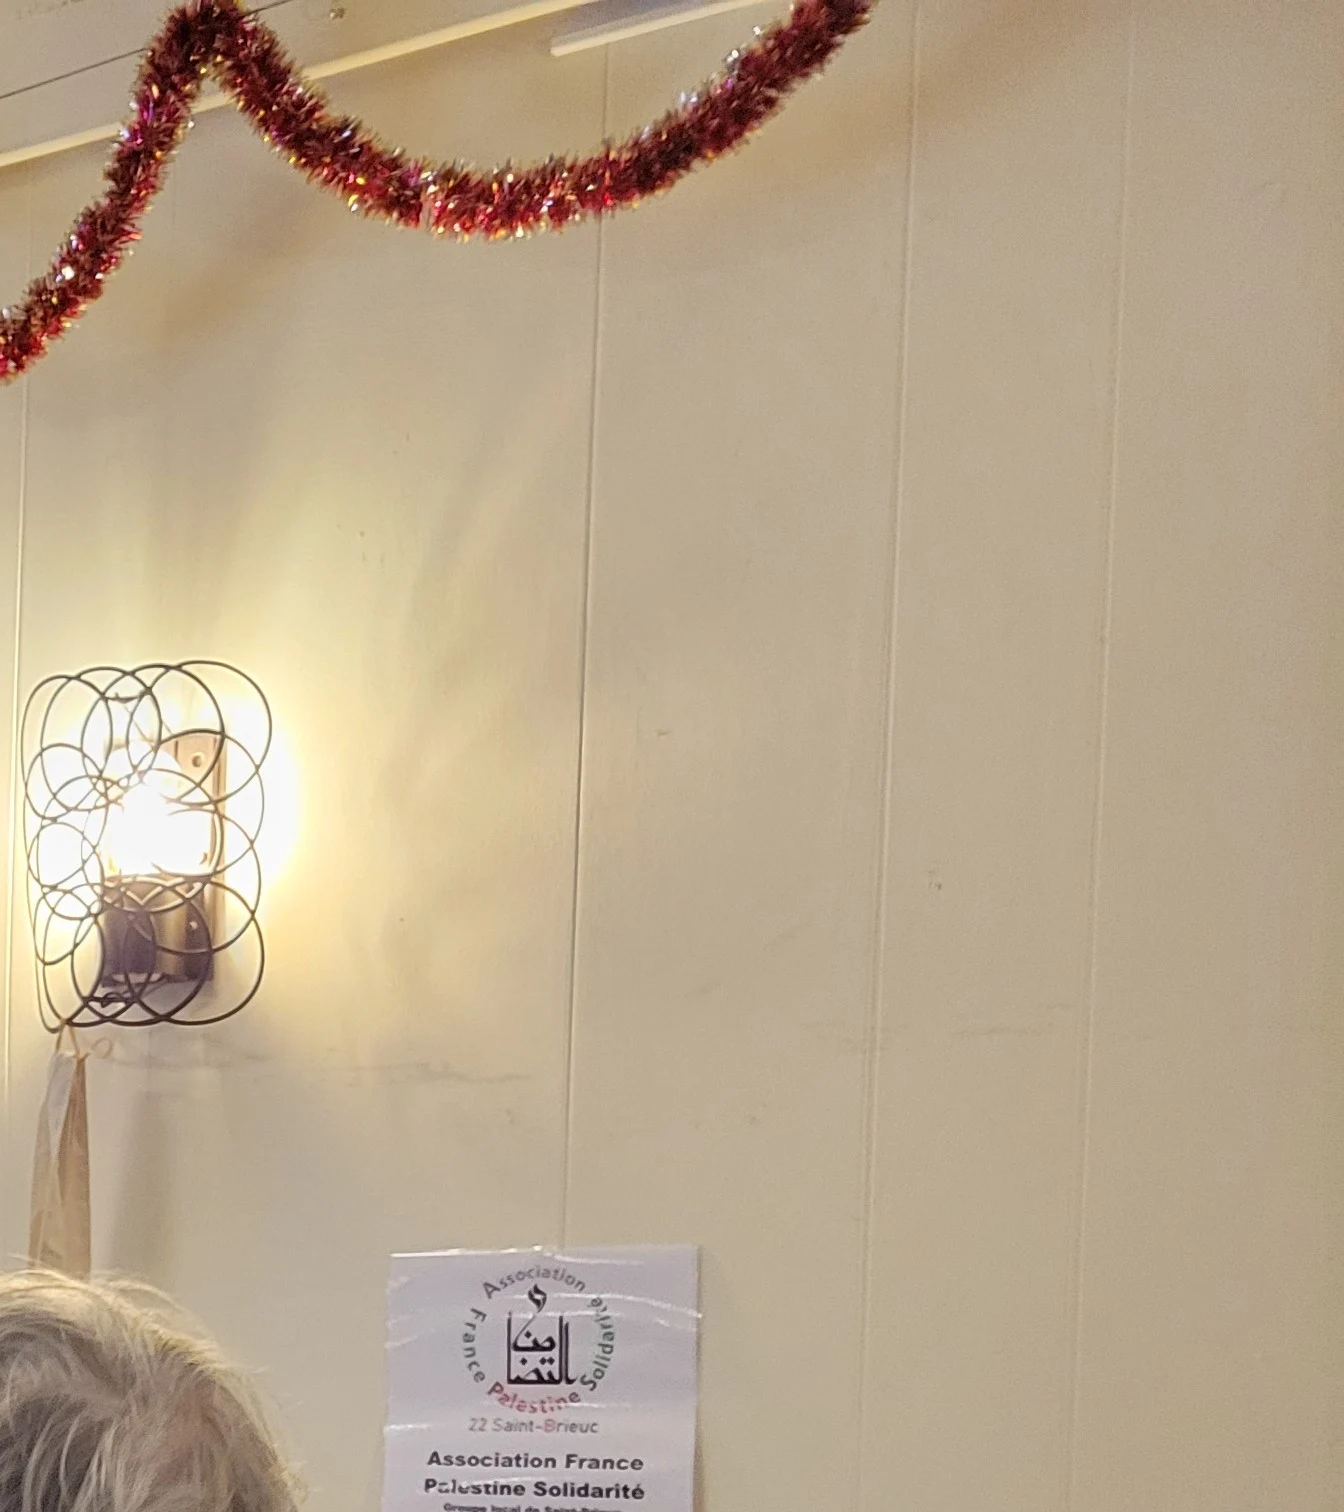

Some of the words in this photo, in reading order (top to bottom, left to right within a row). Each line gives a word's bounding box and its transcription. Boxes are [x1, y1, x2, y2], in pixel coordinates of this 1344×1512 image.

[482, 1265, 586, 1299] Association
[463, 1307, 487, 1383] France
[487, 1381, 581, 1414] Palestine
[468, 1418, 488, 1432] 22
[492, 1417, 600, 1433] Saint-Brieuc
[426, 1450, 558, 1469] Association
[564, 1453, 645, 1471] France
[423, 1478, 527, 1497] Palestine
[533, 1481, 646, 1500] Solidarité
